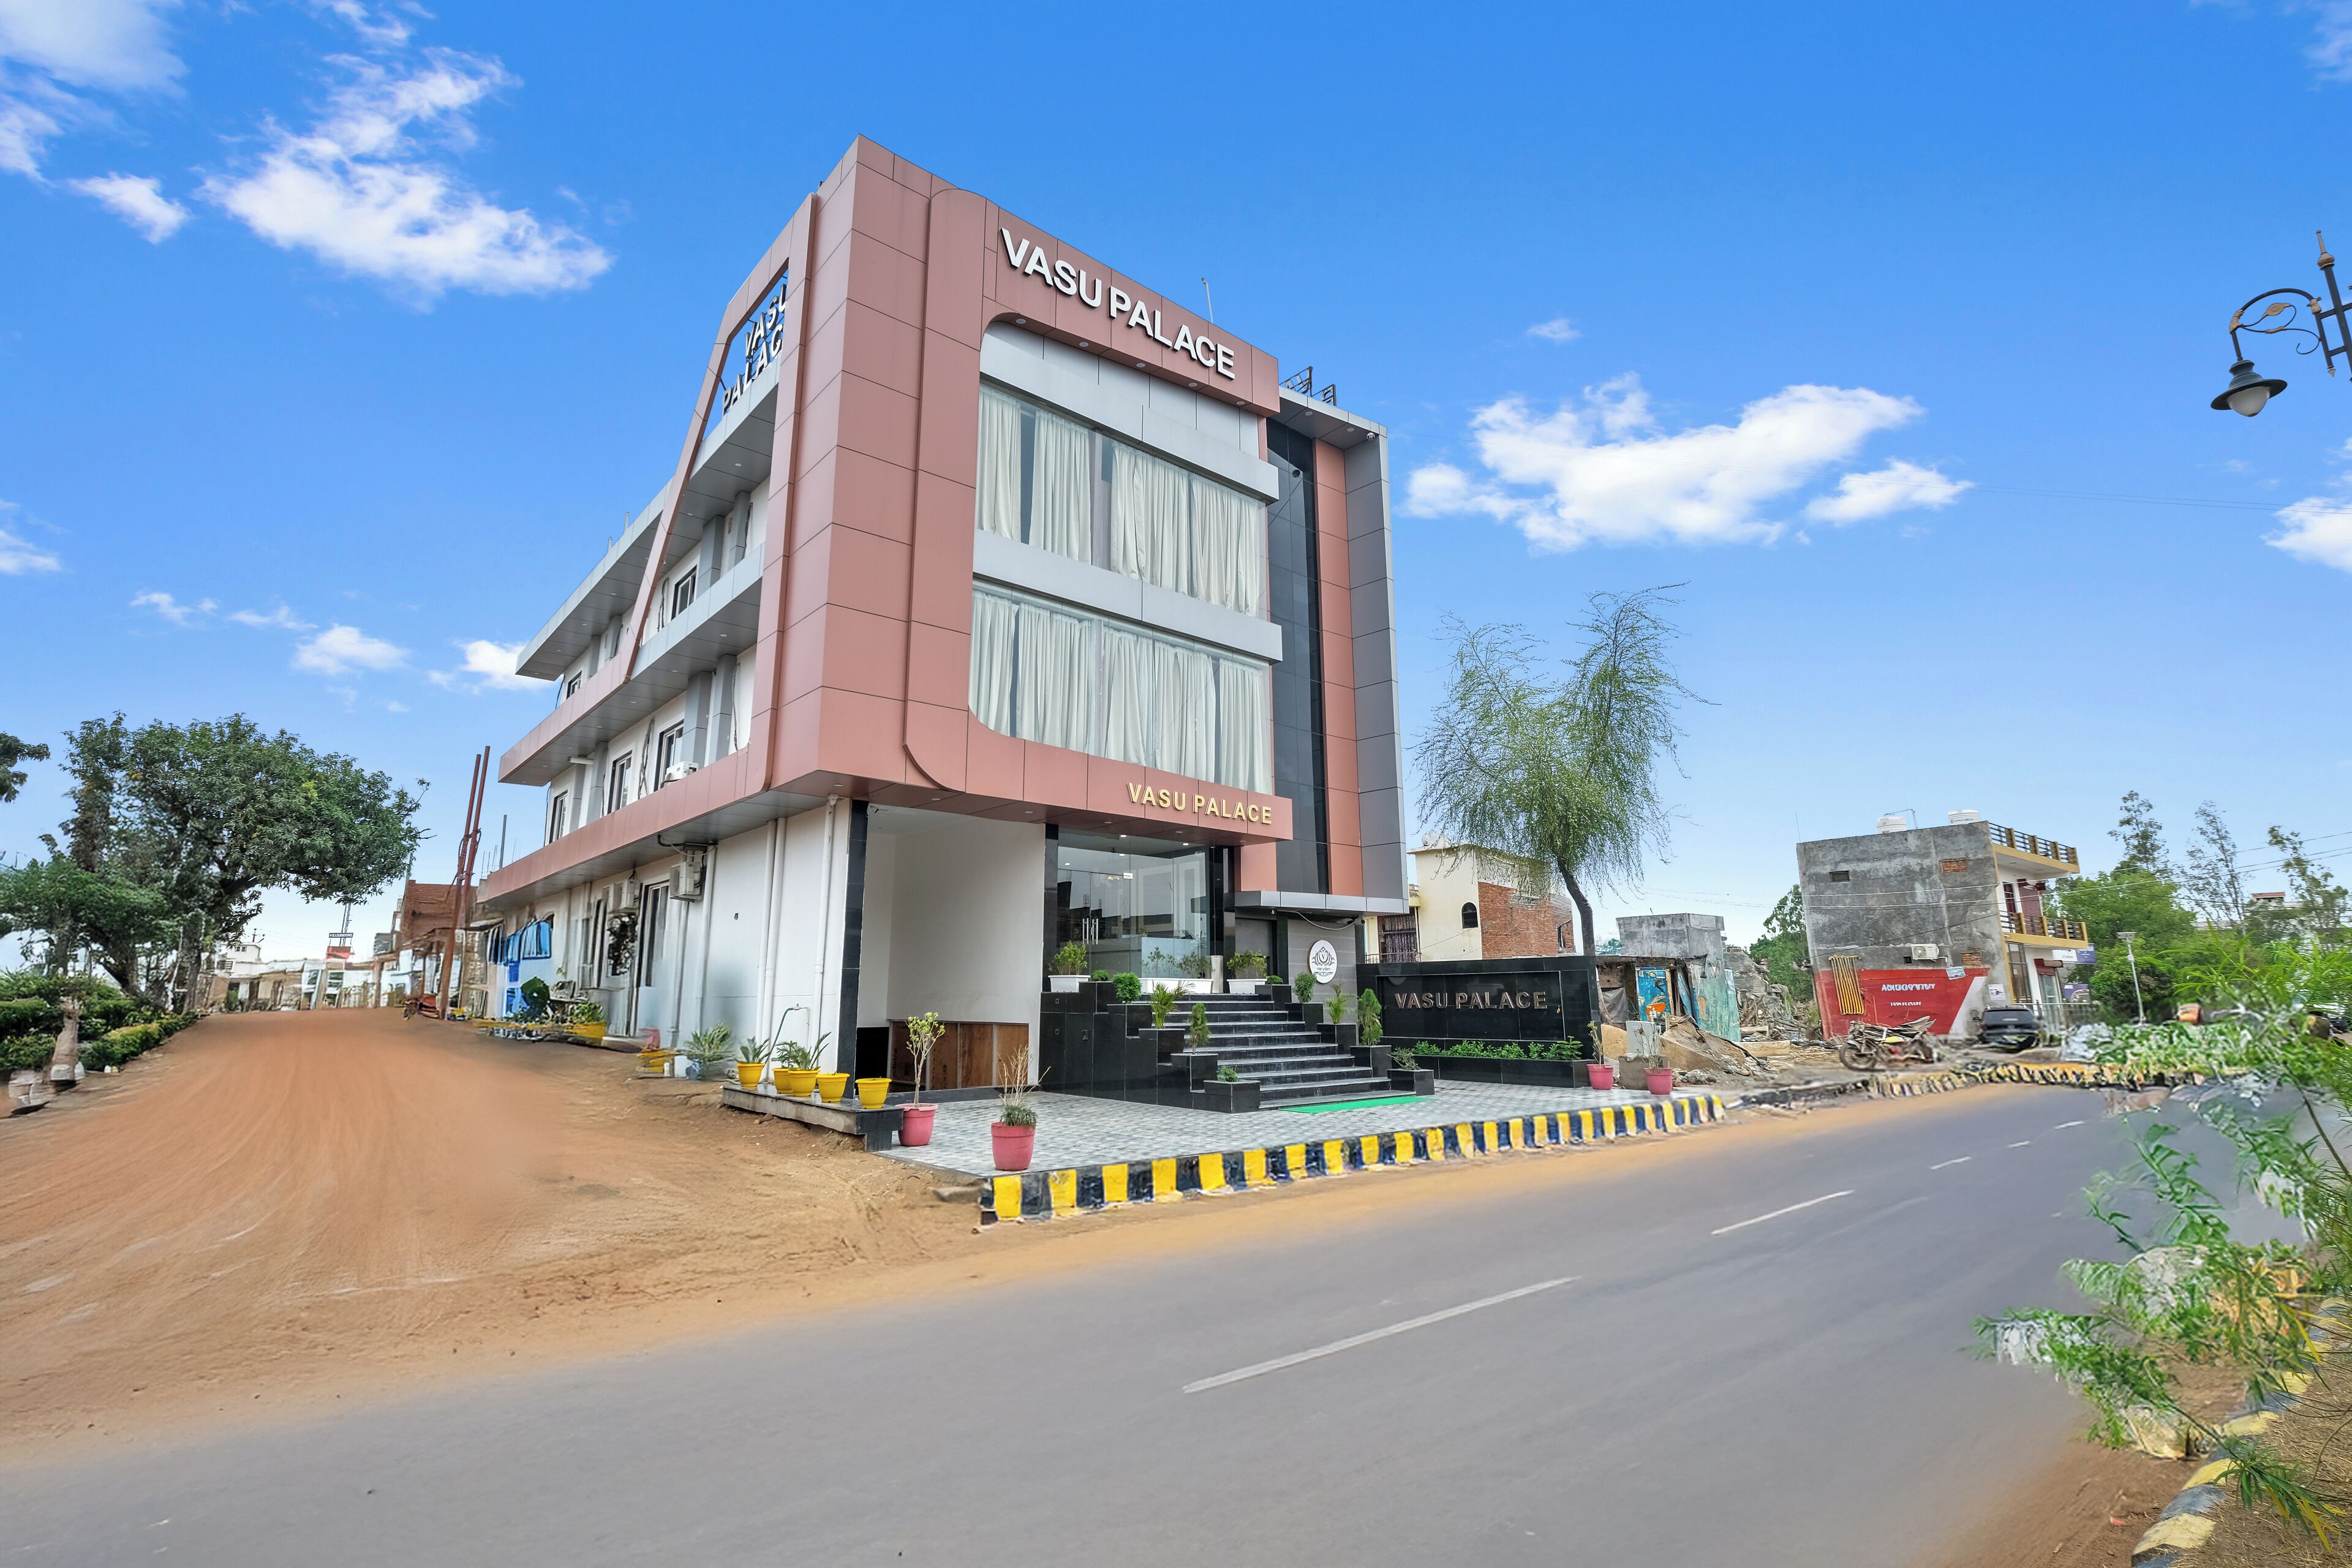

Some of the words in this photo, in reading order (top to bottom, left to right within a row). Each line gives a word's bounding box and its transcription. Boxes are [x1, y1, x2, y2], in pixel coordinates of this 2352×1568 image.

[1000, 227, 1102, 308] VASU
[1109, 285, 1235, 380] PALACE
[722, 323, 783, 415] PALAC
[1127, 782, 1186, 811] VASU
[1193, 794, 1272, 825] PALACE
[1394, 992, 1448, 1009] VASU
[1455, 991, 1548, 1009] PALACE
